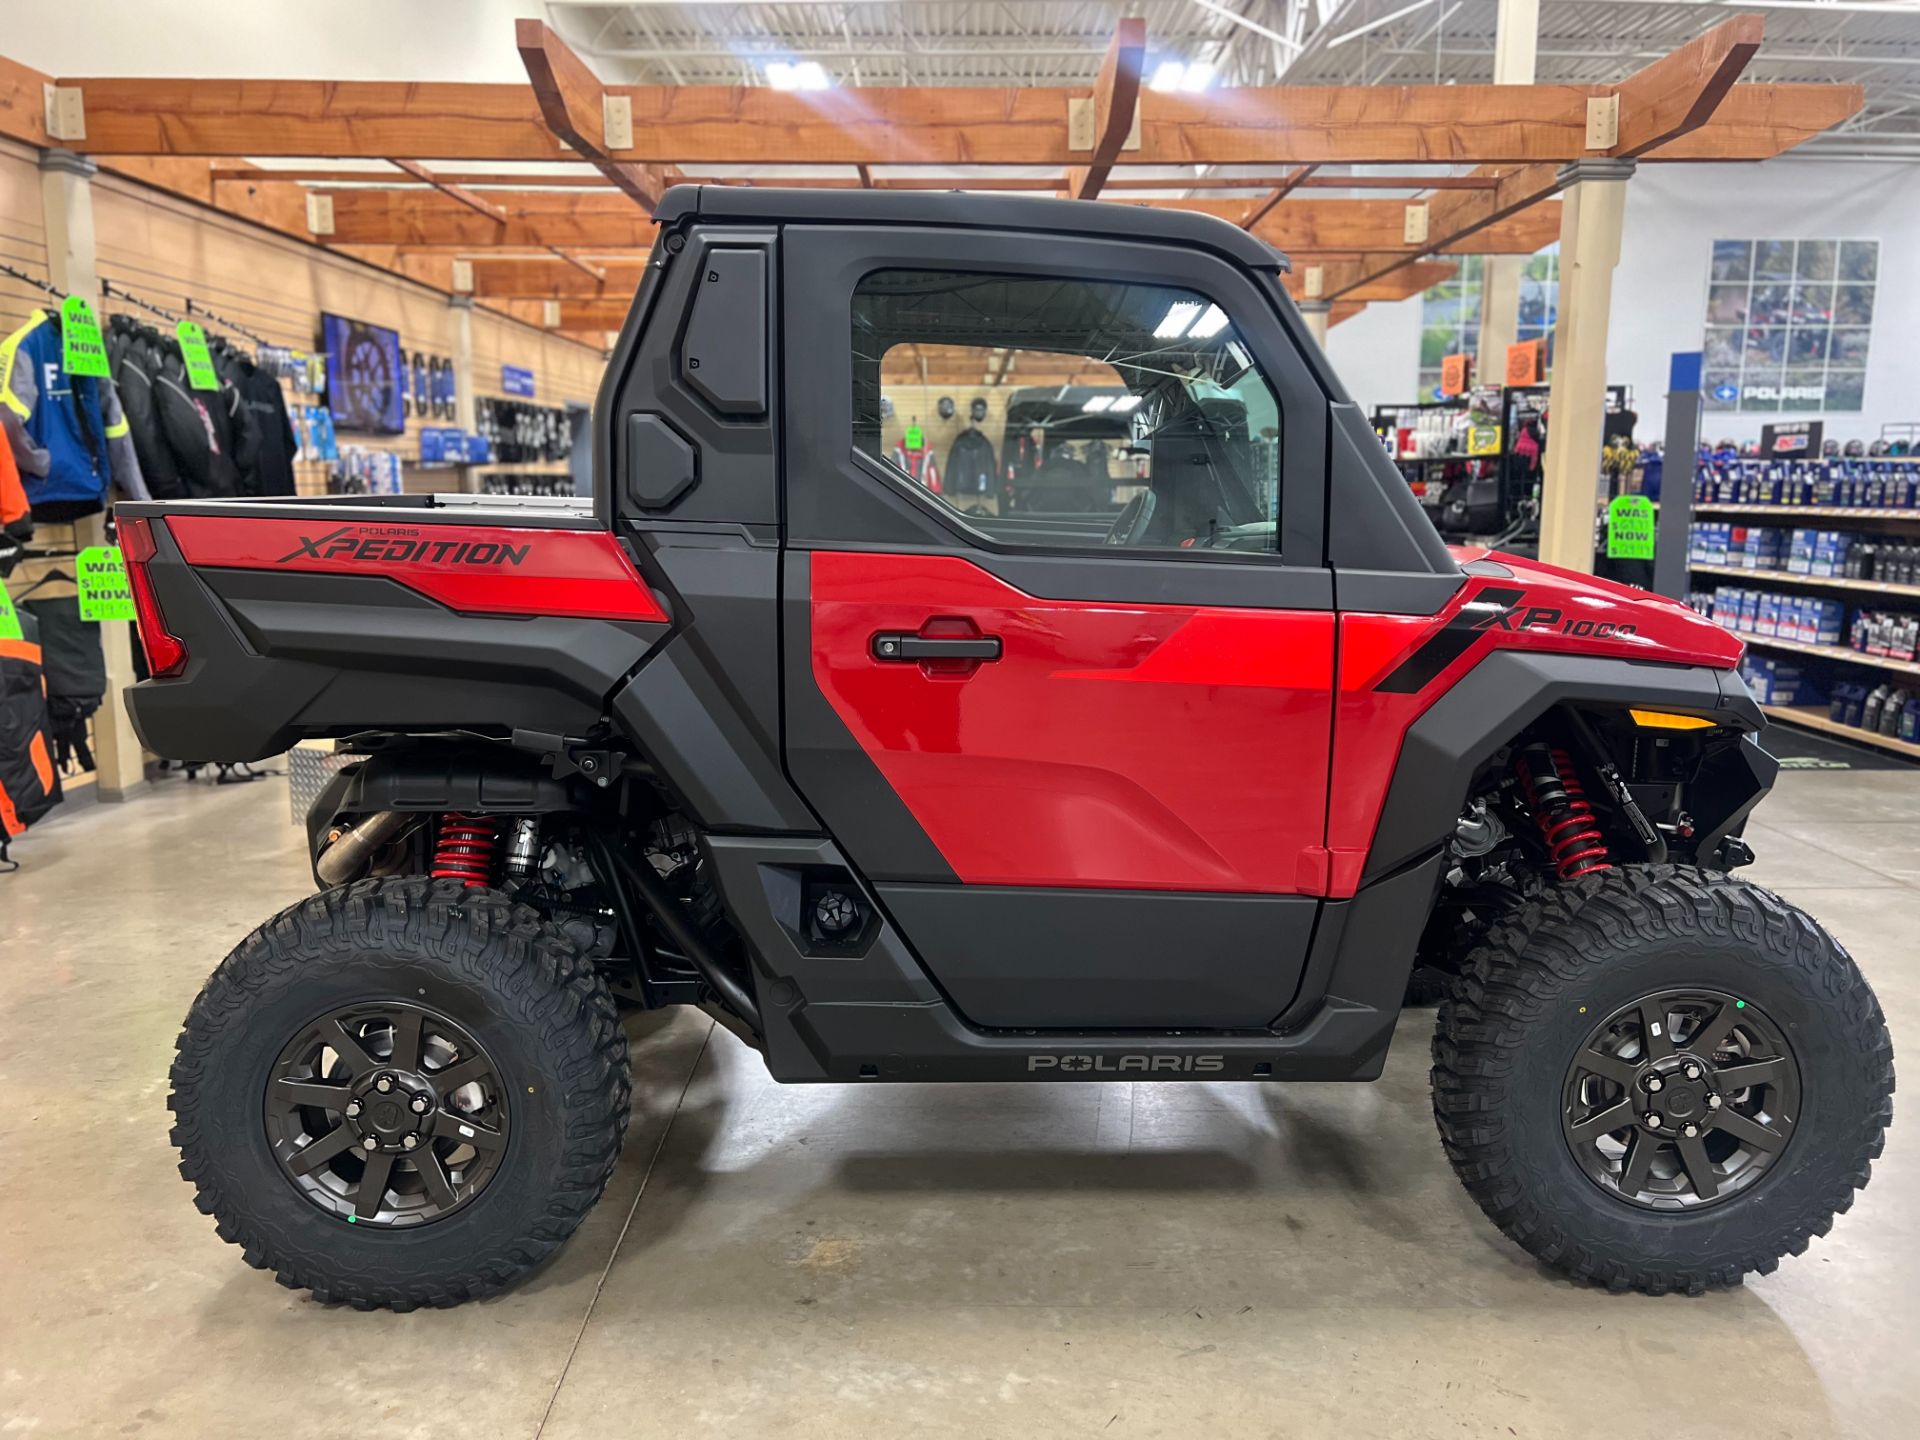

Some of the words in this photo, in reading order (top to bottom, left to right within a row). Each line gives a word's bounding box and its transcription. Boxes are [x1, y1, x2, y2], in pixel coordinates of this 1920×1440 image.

[70, 341, 102, 355] NOW
[1743, 386, 1825, 400] POLARIS
[1616, 508, 1649, 518] WAS
[359, 527, 420, 537] POLARIS
[1615, 531, 1649, 541] NOW
[275, 527, 531, 566] XPEDITION
[87, 589, 132, 600] NOW
[1471, 606, 1563, 632] XP
[1561, 619, 1637, 639] 1000
[1028, 1055, 1224, 1072] POLARIS
